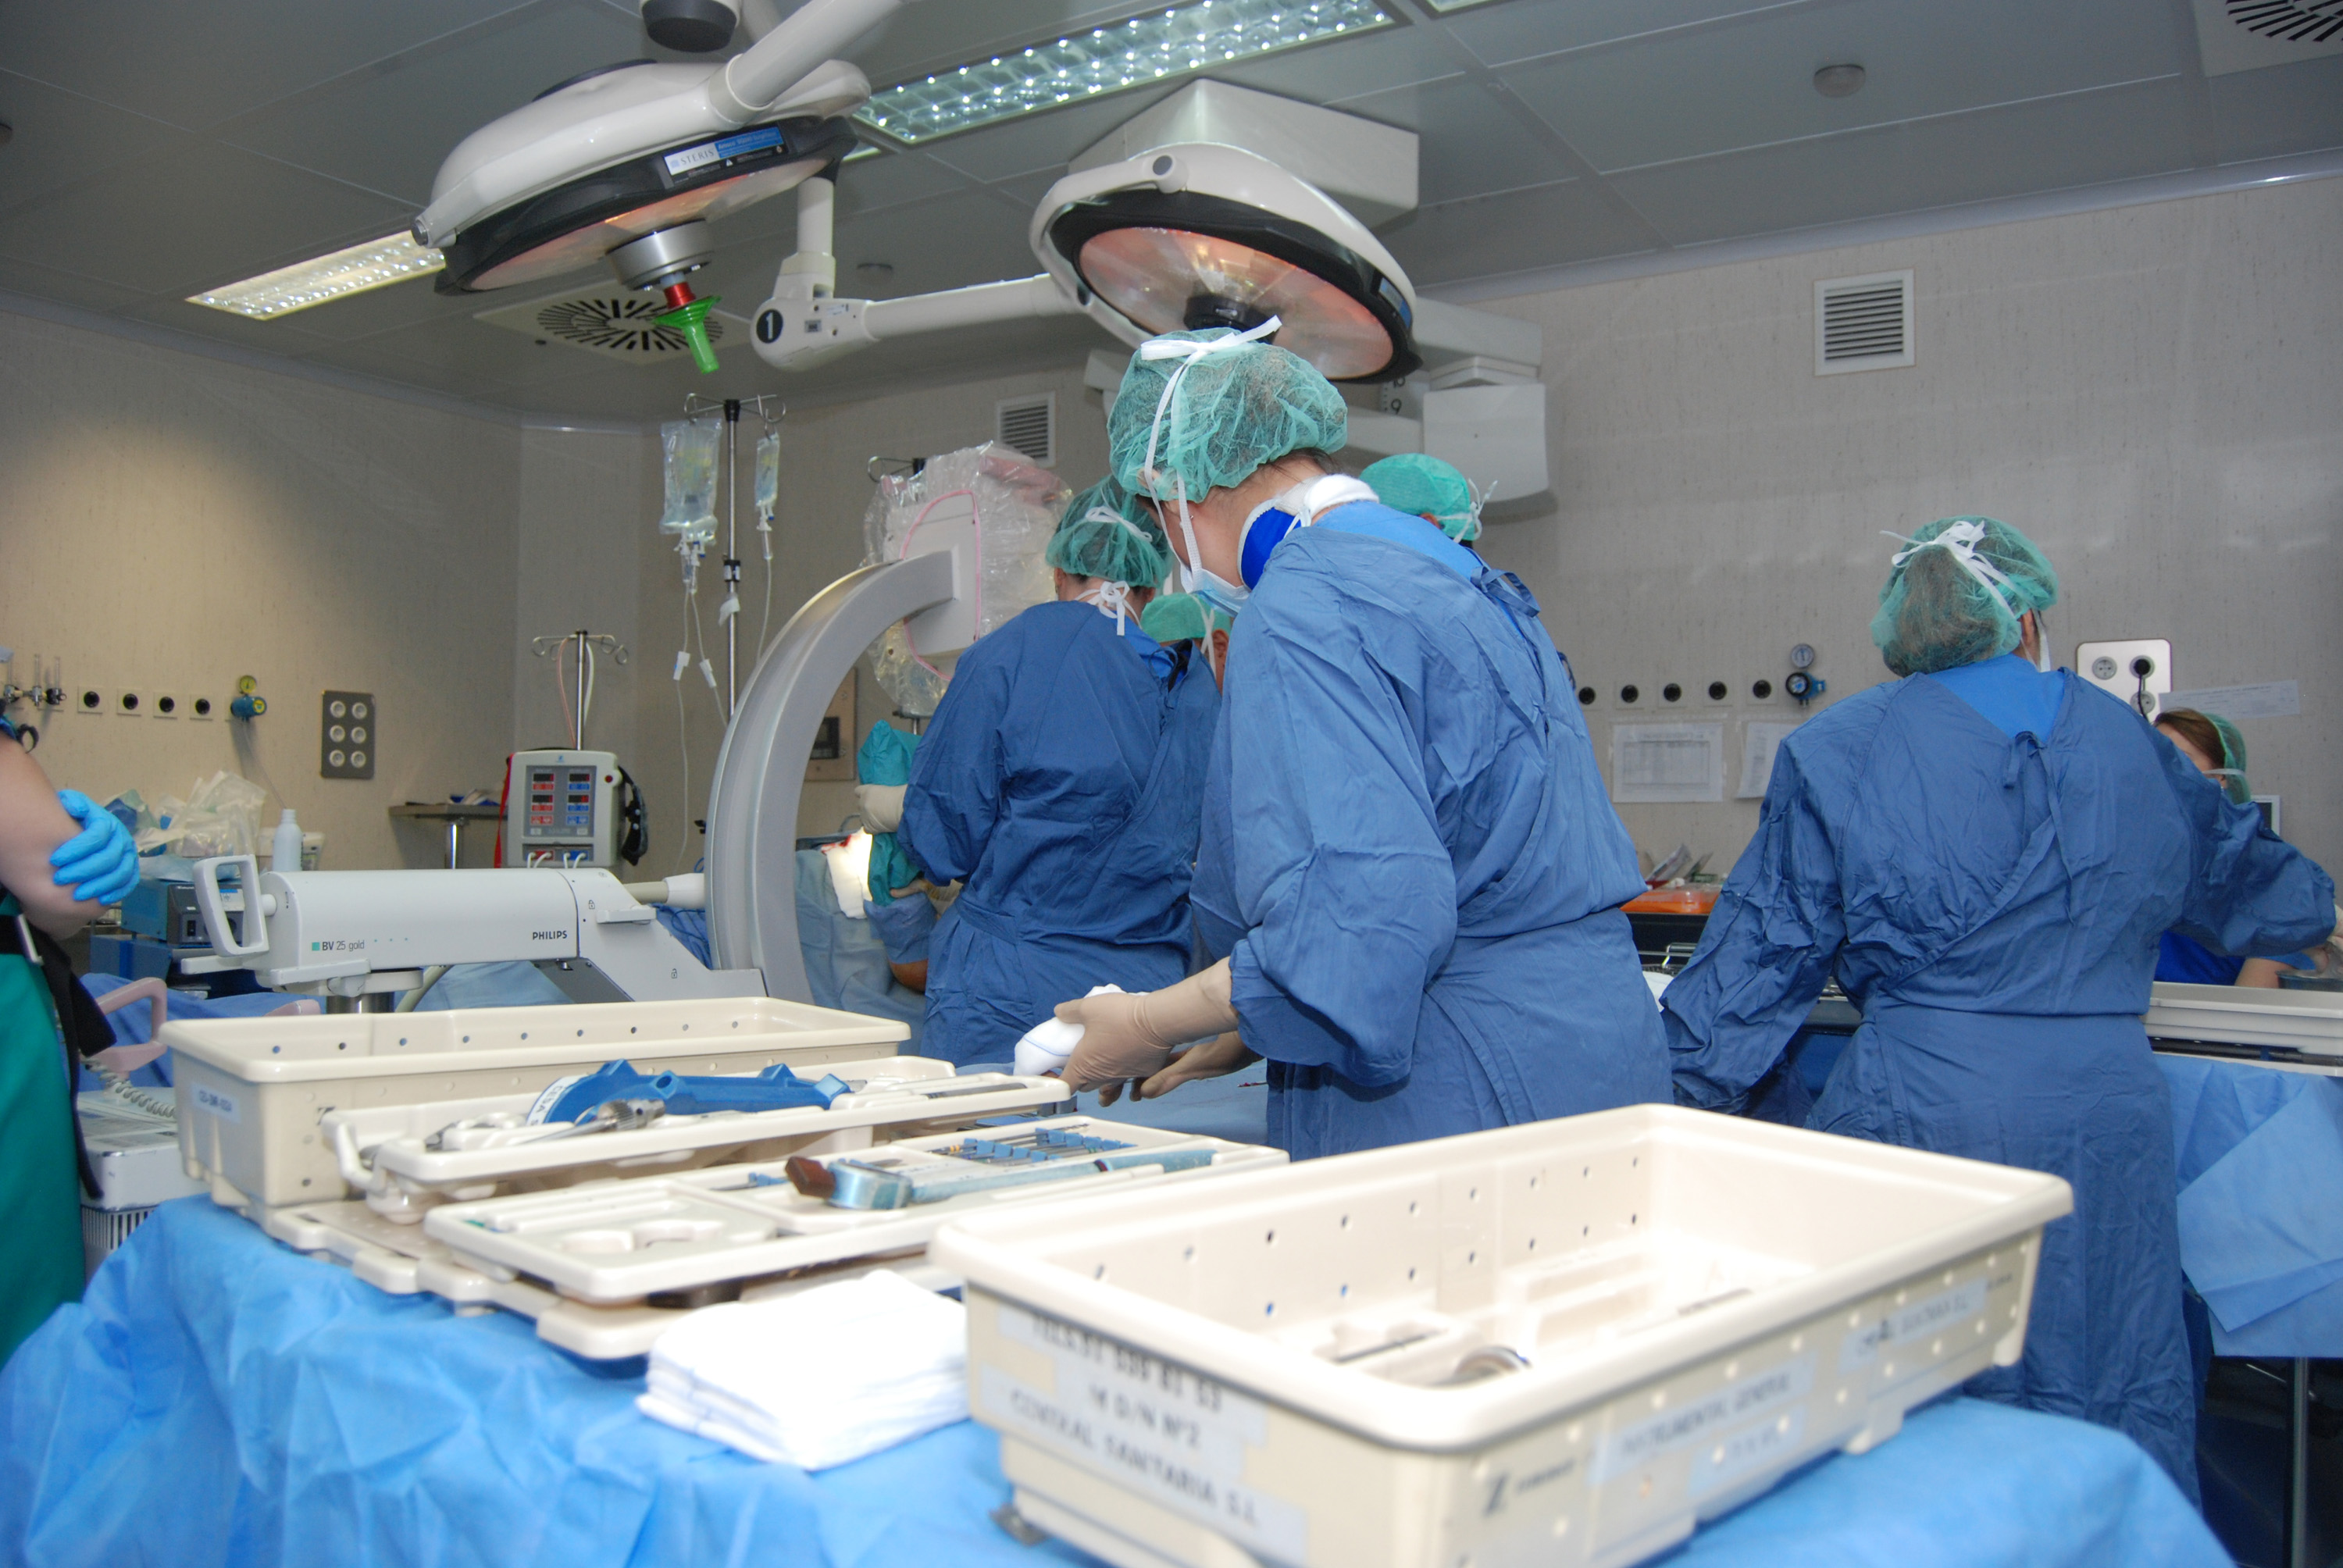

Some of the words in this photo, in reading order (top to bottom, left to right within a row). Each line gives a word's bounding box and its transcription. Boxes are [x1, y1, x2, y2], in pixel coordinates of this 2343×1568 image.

[680, 148, 715, 166] STERIS
[765, 312, 773, 340] 1
[533, 930, 568, 940] PHILIPS
[322, 941, 334, 951] BV
[336, 940, 346, 950] 25
[348, 939, 365, 952] gold
